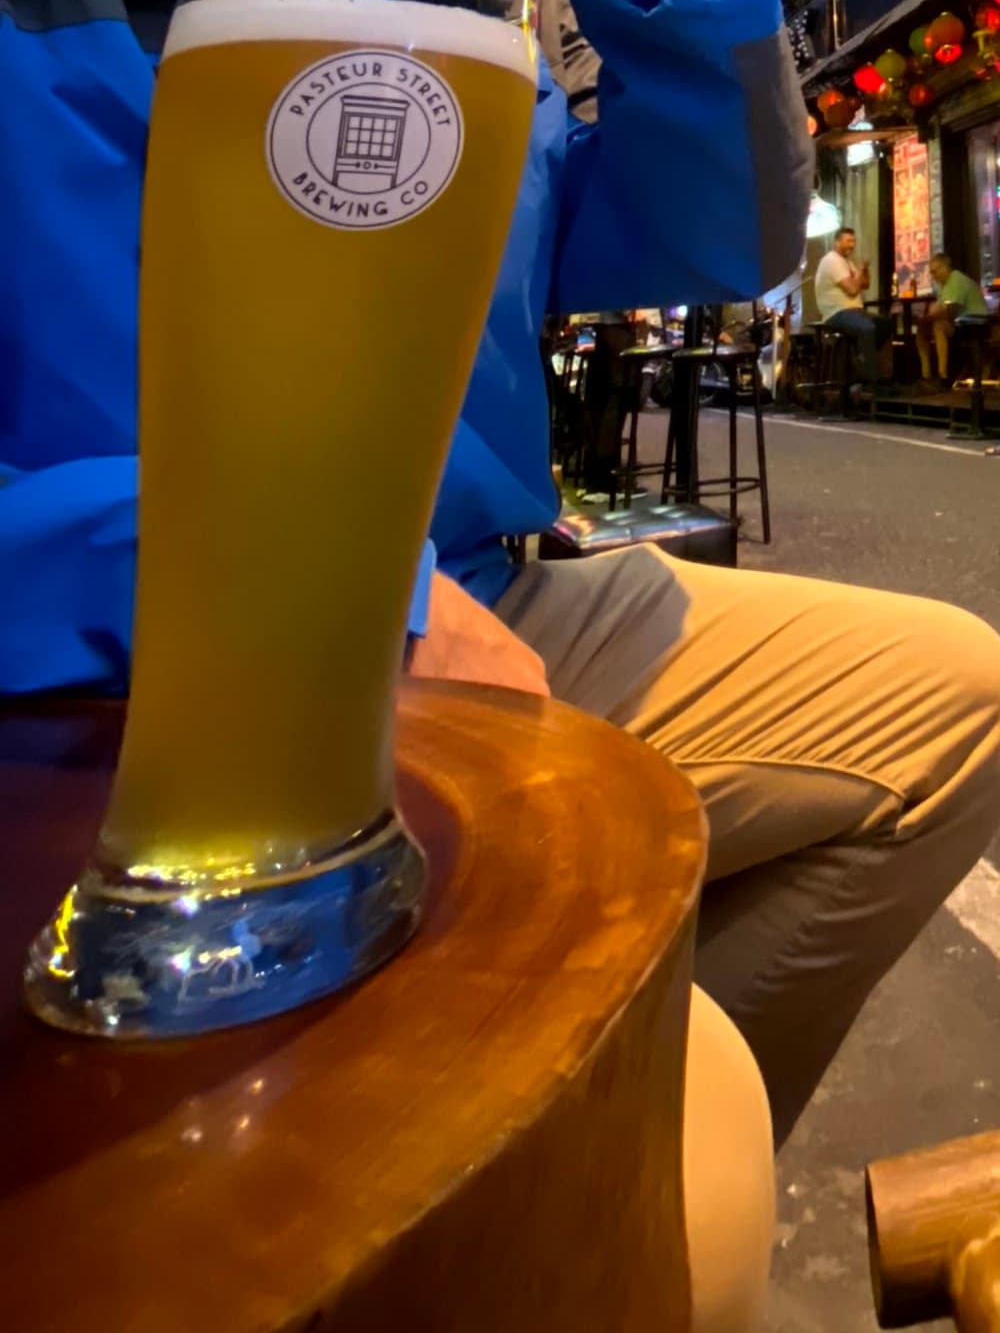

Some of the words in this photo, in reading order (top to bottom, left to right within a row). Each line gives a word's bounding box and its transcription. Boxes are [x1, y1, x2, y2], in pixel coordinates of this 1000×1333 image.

[290, 63, 383, 116] PASTEUR
[396, 68, 450, 125] STREET
[292, 172, 388, 217] BREWING
[400, 180, 429, 205] CO
